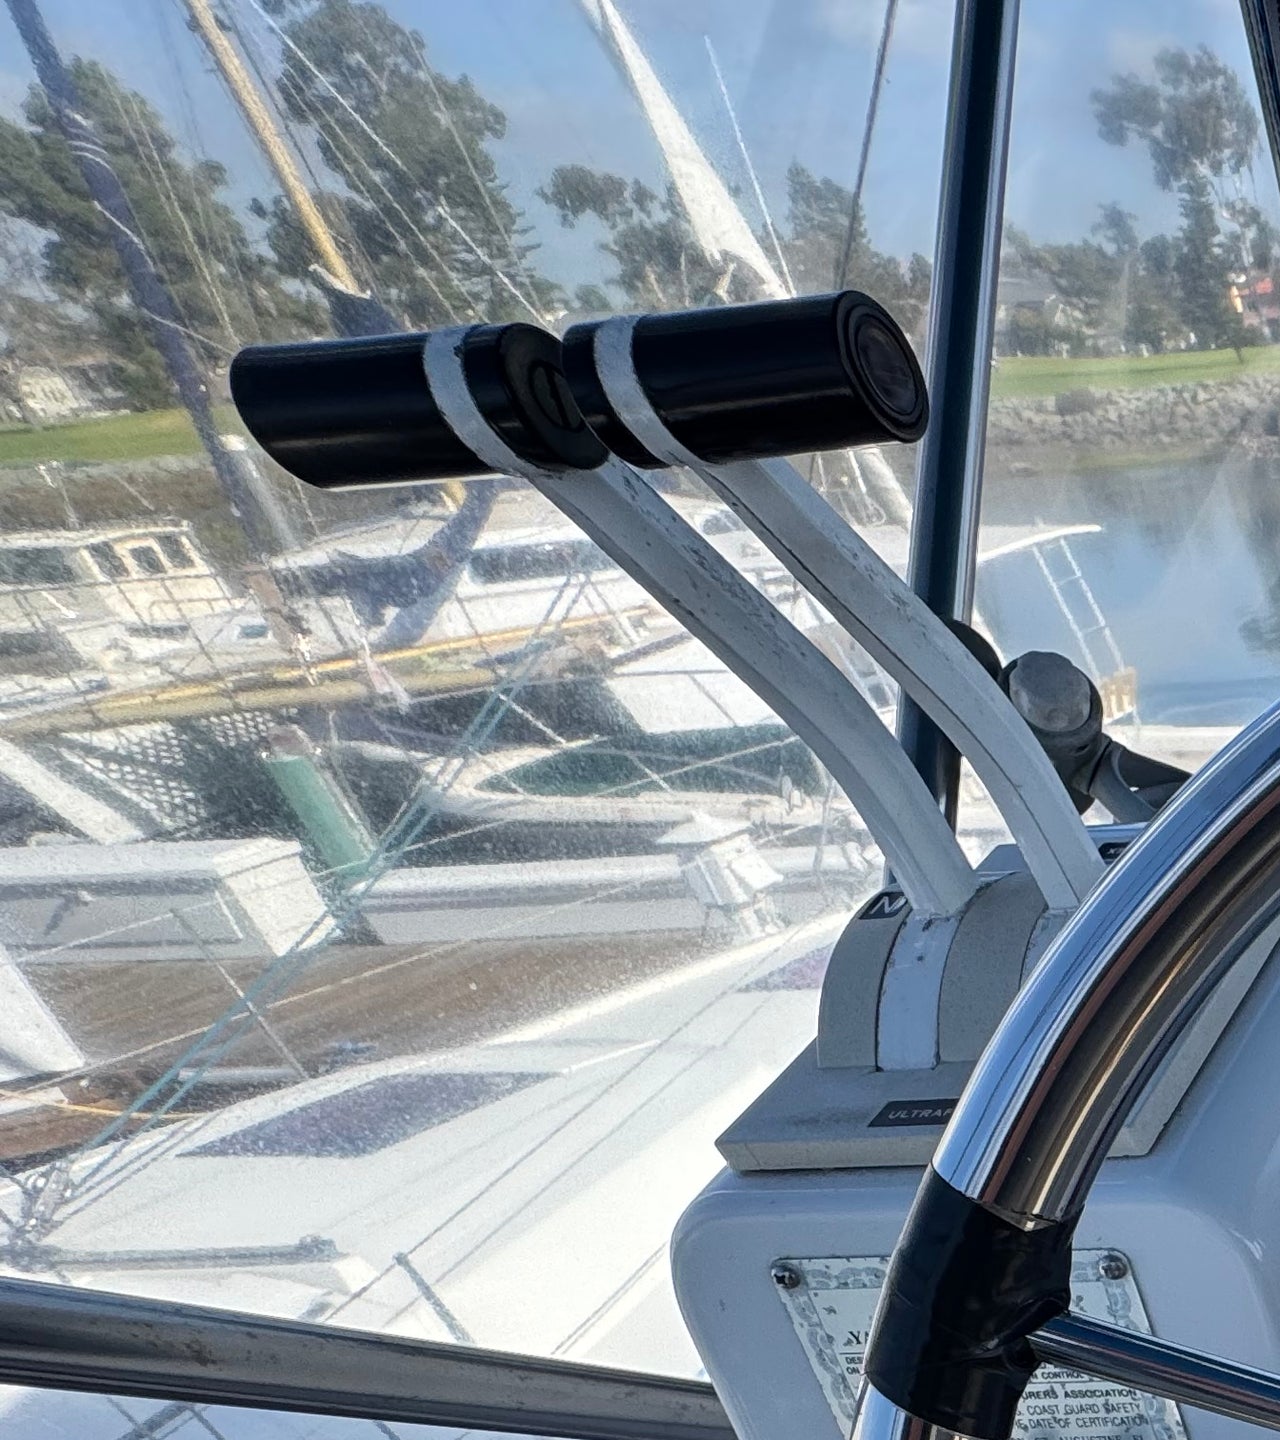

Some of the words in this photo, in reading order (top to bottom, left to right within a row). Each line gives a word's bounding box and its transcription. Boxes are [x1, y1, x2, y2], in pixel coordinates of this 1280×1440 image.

[1064, 1389, 1138, 1400] ASSOCIATION
[1027, 1405, 1060, 1416] COAST
[1064, 1404, 1100, 1415] GUARD
[1103, 1402, 1141, 1414] SAFETY
[1028, 1418, 1055, 1429] DATE
[1075, 1415, 1149, 1428] CERTIFICATION
